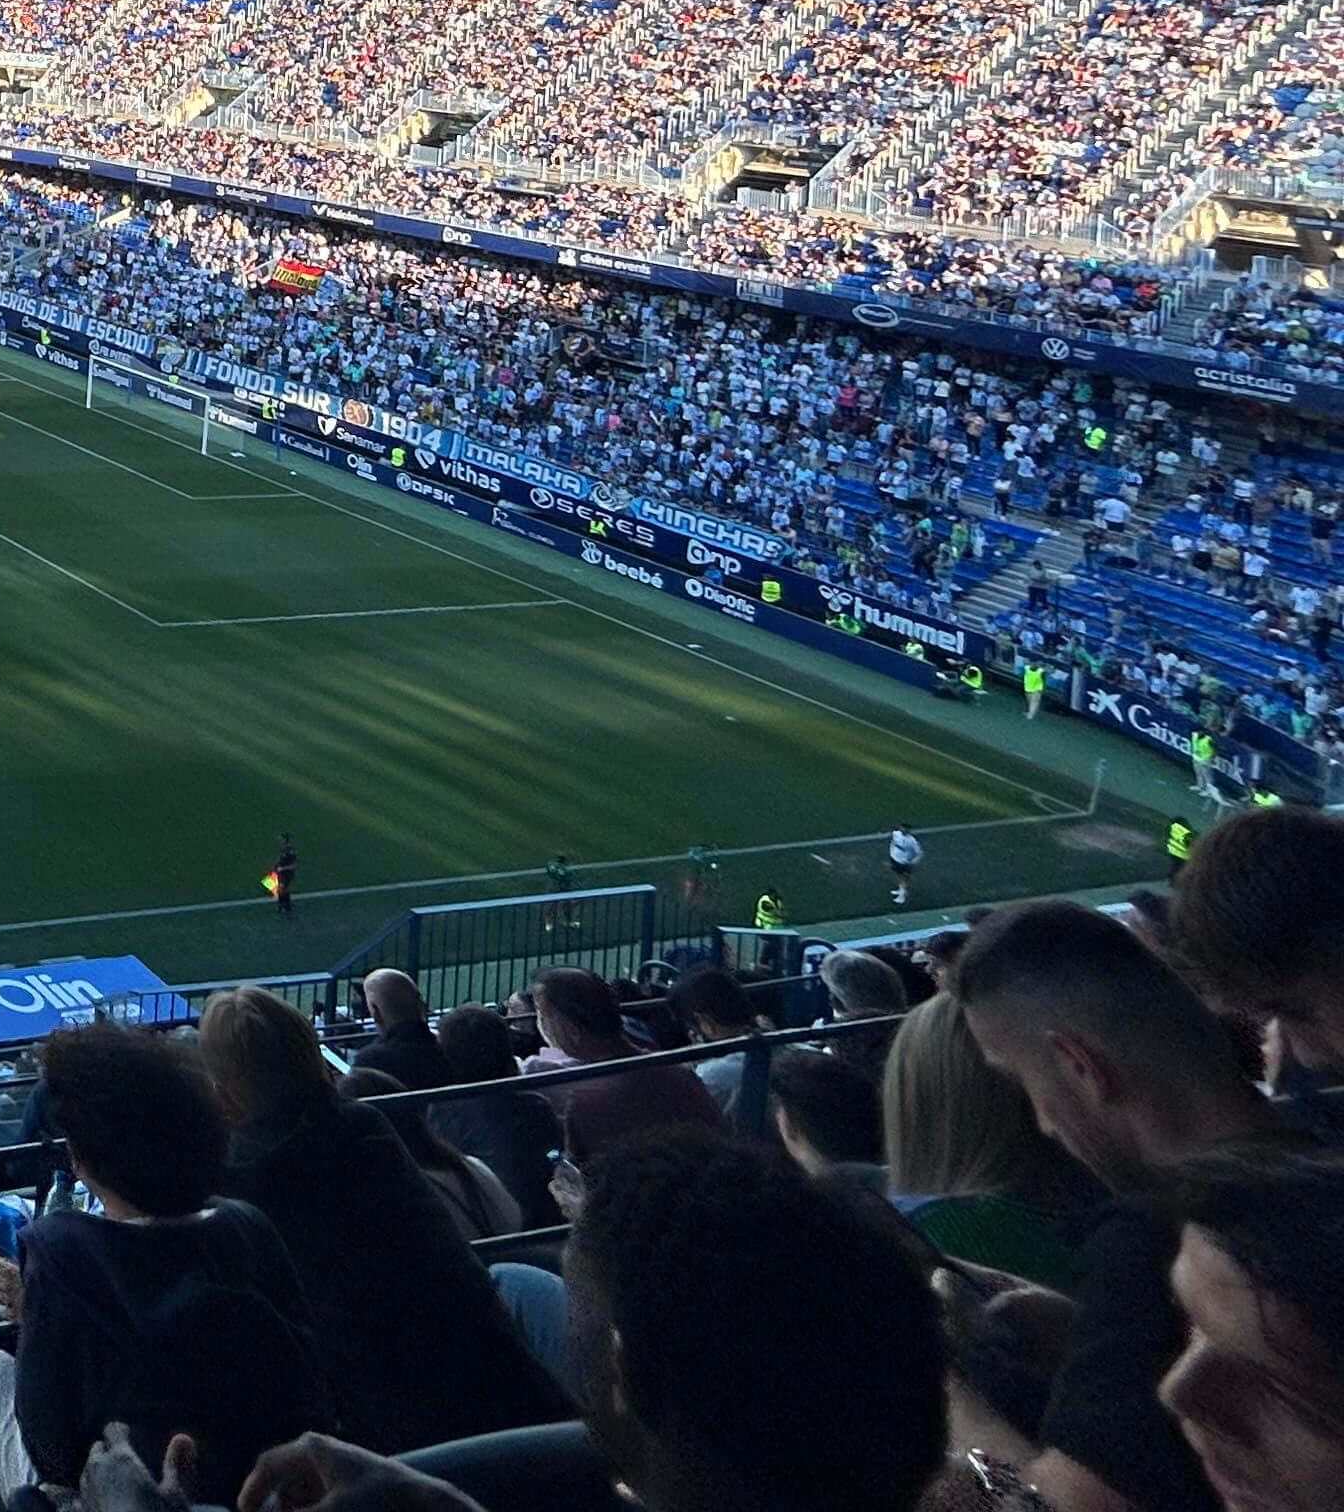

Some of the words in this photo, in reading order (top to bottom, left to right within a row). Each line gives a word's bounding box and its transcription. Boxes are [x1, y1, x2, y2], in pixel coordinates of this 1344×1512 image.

[38, 301, 59, 323] DE
[62, 309, 83, 332] UN
[86, 316, 150, 354] ESCUDO
[48, 349, 79, 371] vithas
[1194, 367, 1297, 395] acristalia
[204, 356, 276, 397] FONDO
[282, 380, 331, 416] SUR
[380, 411, 442, 452] 1904
[335, 427, 387, 454] Sanamar
[346, 453, 373, 473] Olin
[440, 460, 501, 493] vithas
[411, 480, 455, 505] DFSK
[557, 498, 654, 543] SERES
[642, 500, 783, 558] HINCHAS
[604, 553, 664, 589] beebé
[853, 596, 965, 655] hummel
